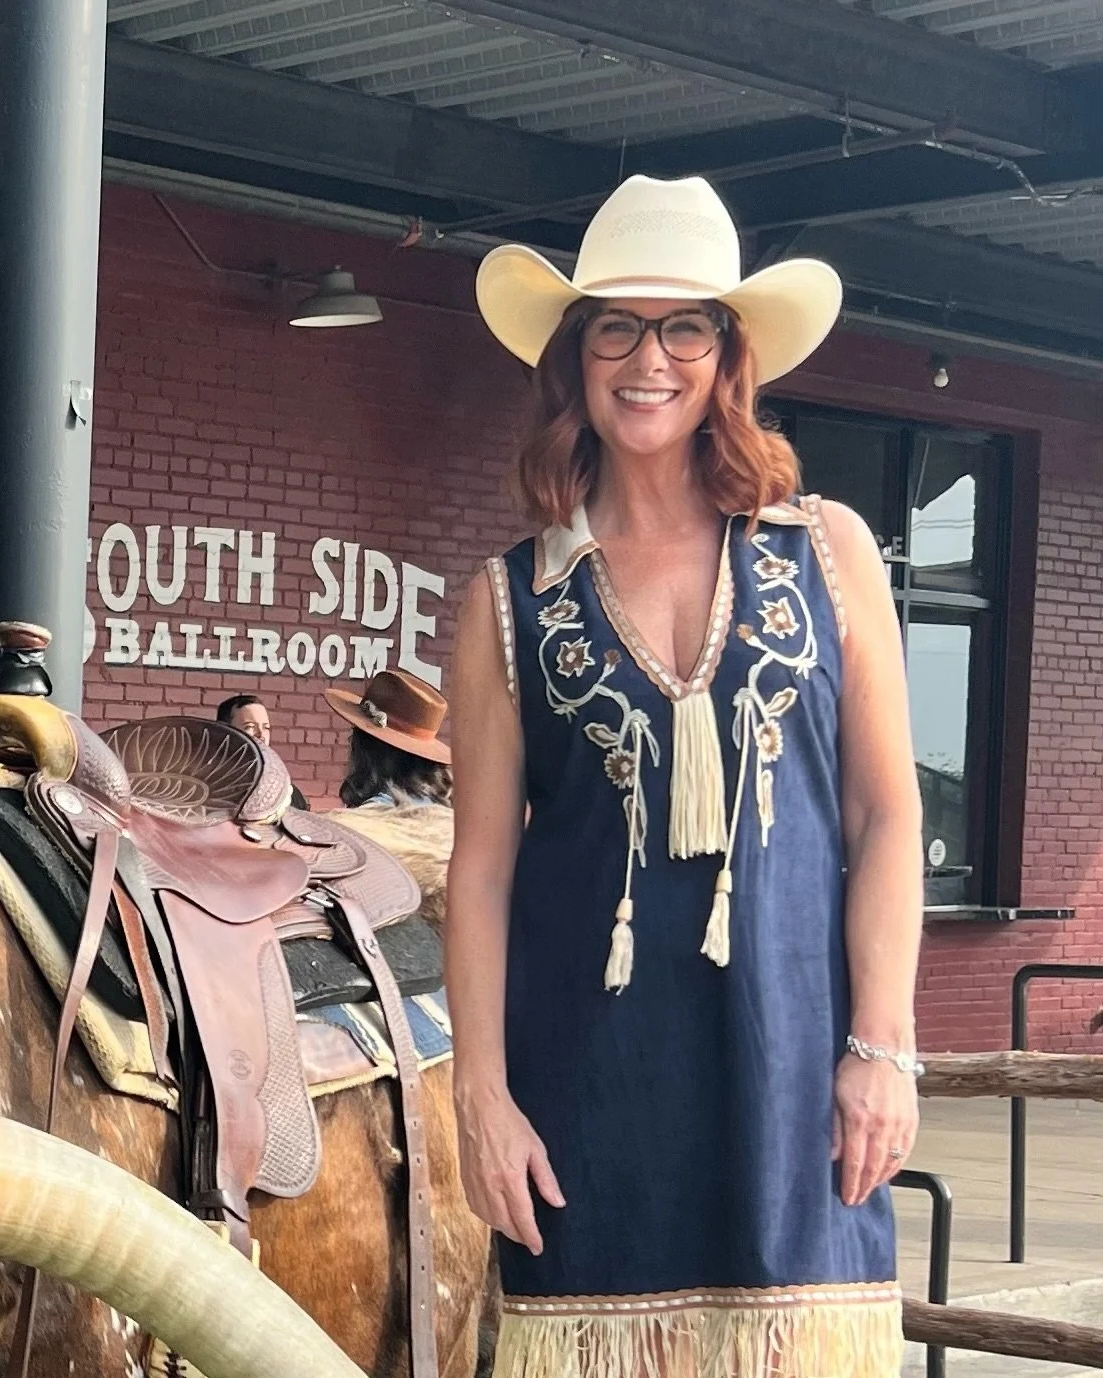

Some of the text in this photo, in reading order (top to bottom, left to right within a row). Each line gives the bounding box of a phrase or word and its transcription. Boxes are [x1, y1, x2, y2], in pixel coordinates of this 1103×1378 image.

[87, 522, 445, 690] OUTH SIDE
[104, 617, 394, 679] BALLROOM
